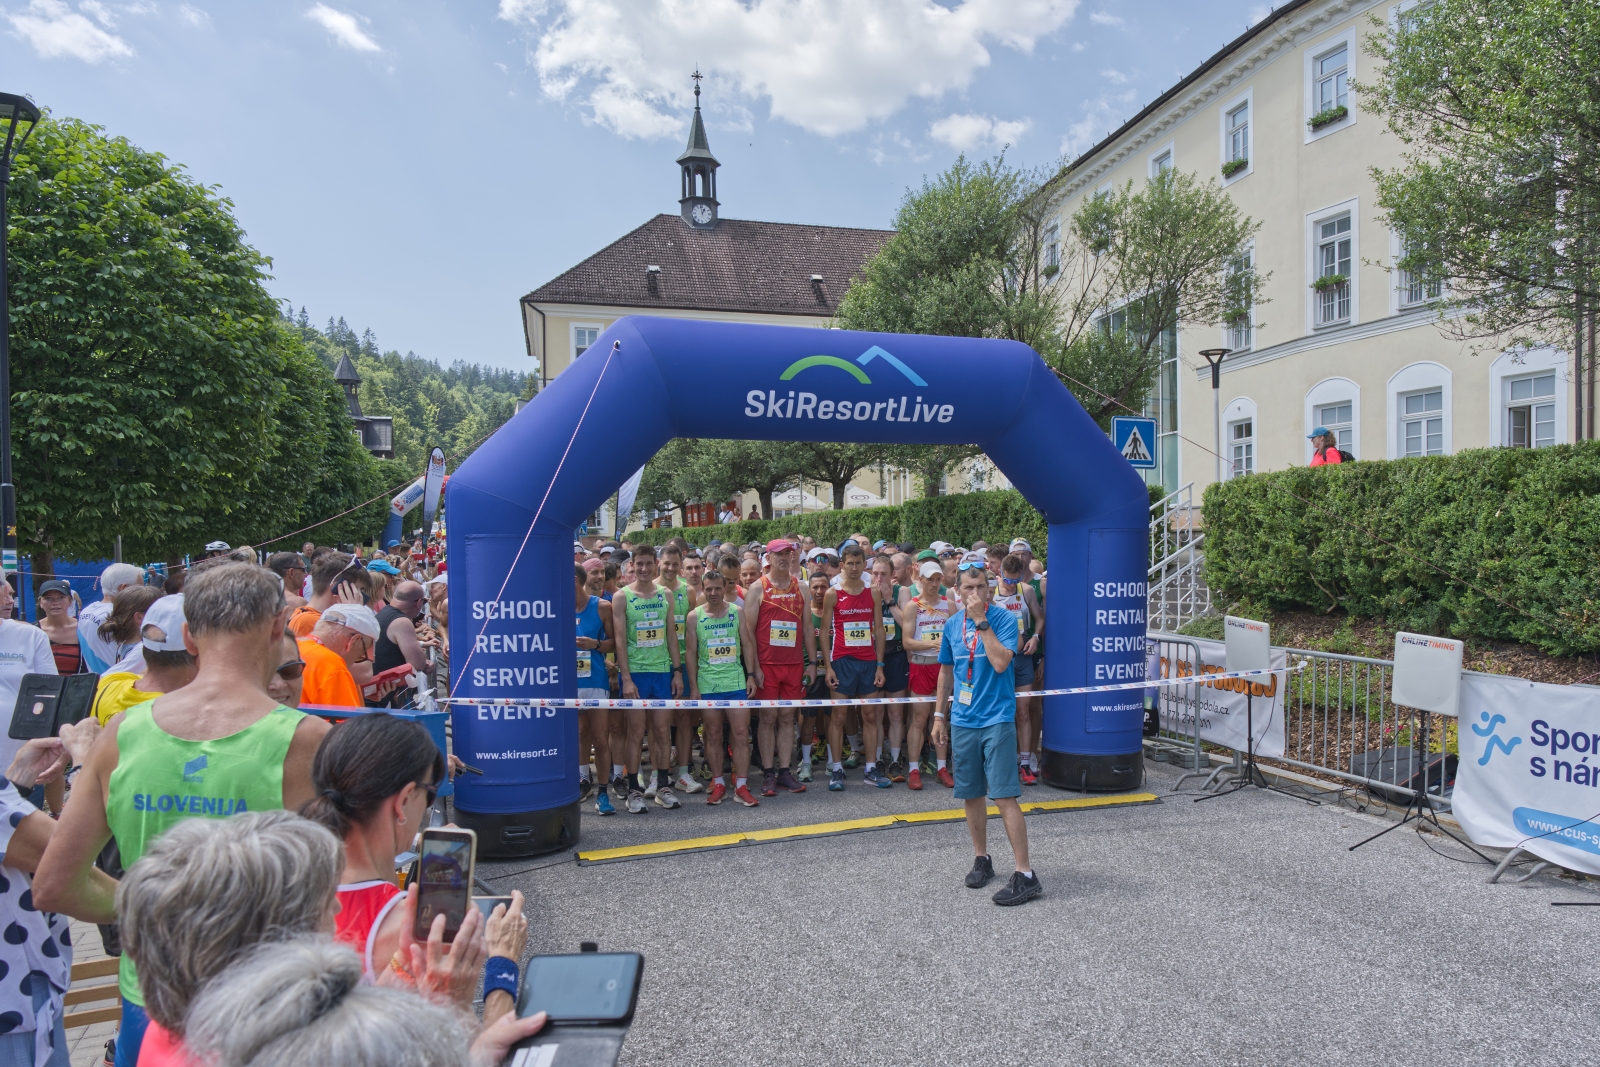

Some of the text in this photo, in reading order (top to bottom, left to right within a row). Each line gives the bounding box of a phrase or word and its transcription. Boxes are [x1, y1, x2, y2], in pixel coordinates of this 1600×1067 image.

[744, 389, 955, 423] SkiResortLive
[1093, 581, 1147, 598] SCHOOL
[472, 600, 556, 619] SCHOOL
[1006, 603, 1022, 611] MANY
[1095, 609, 1145, 625] RENTAL
[646, 629, 657, 639] 33
[704, 622, 734, 631] SLOVENIJA
[778, 629, 789, 638] 26
[850, 630, 865, 638] 425
[475, 633, 554, 653] RENTAL
[714, 646, 731, 656] 609
[1092, 635, 1145, 653] SERVICE
[1401, 636, 1455, 651] ONLINETIMING
[473, 666, 559, 687] SERVICE
[1095, 662, 1144, 680] EVENTS
[477, 704, 557, 720] EVENTS
[475, 748, 558, 760] www.skiresort.cz
[1529, 756, 1547, 778] s
[133, 793, 248, 816] SLOVENIJA
[1527, 818, 1600, 849] www.cus-s
